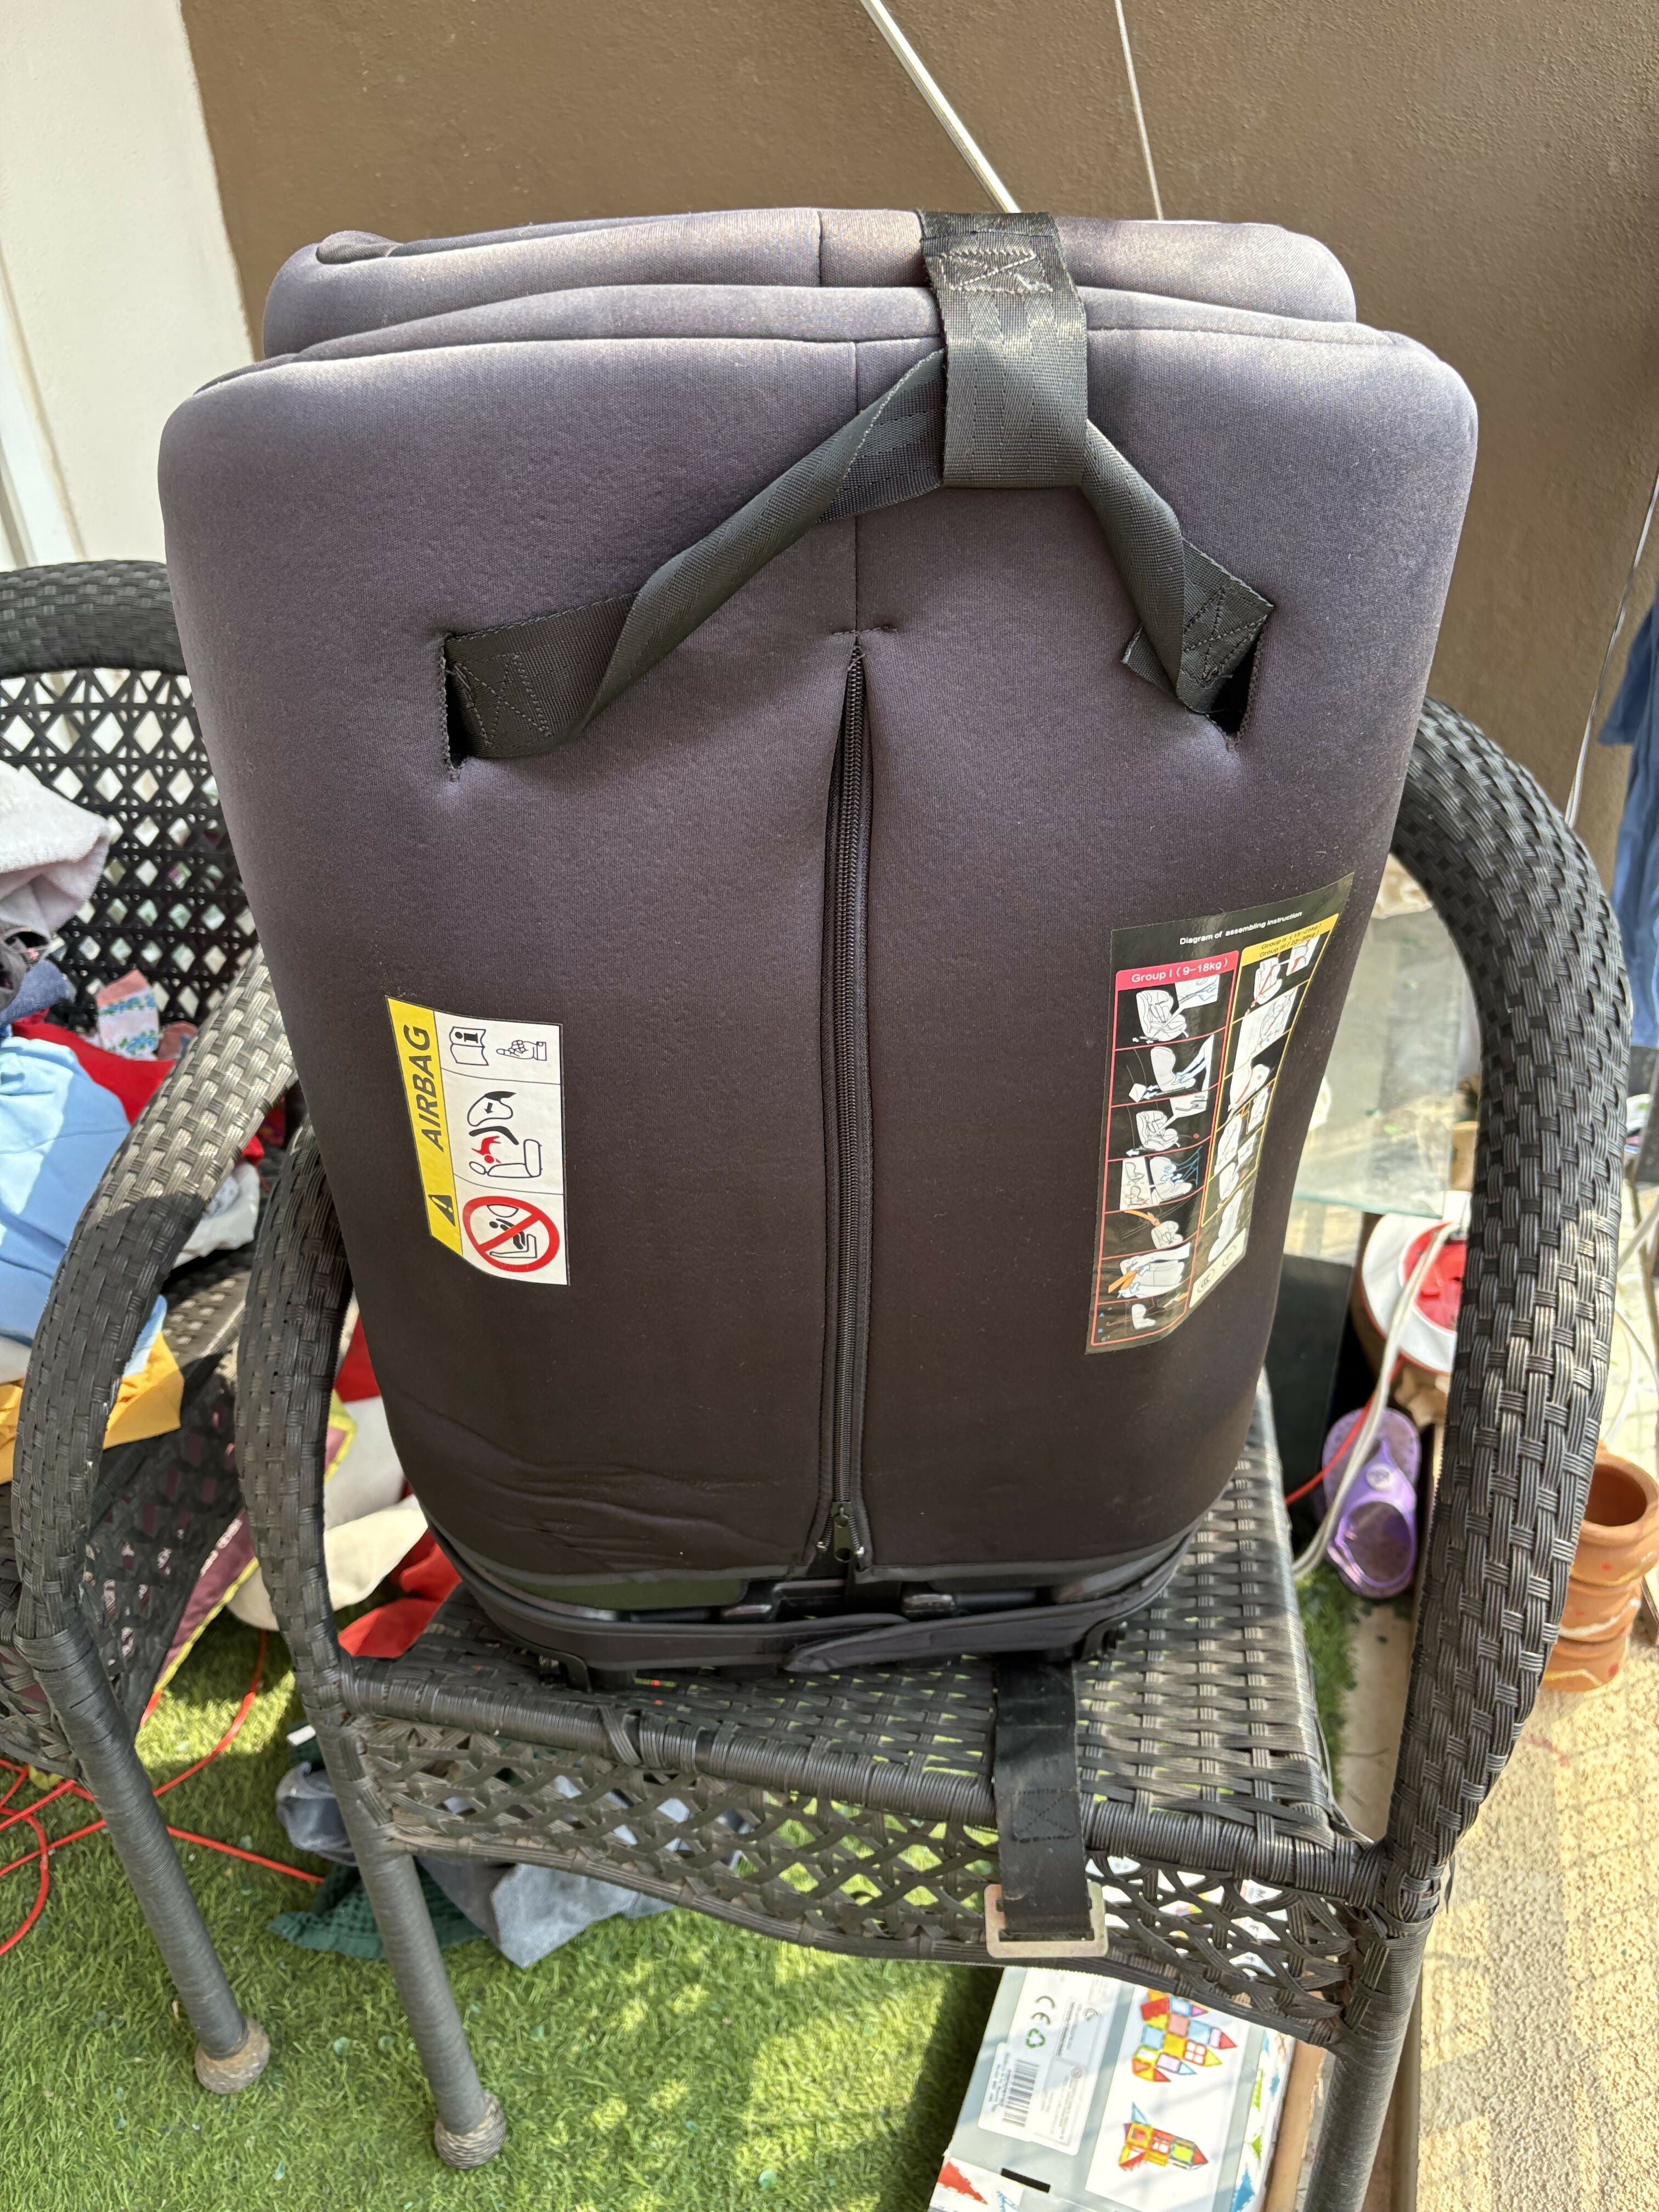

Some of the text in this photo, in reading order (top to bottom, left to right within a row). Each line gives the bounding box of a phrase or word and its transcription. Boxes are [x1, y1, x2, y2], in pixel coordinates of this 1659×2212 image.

[1180, 934, 1213, 945] Diagram
[1225, 921, 1266, 936] assembling
[1267, 912, 1302, 926] instruction
[1261, 939, 1281, 950] Group
[1260, 947, 1279, 958] Group
[1131, 972, 1166, 983] Group
[403, 1024, 444, 1153] AIRBAG
